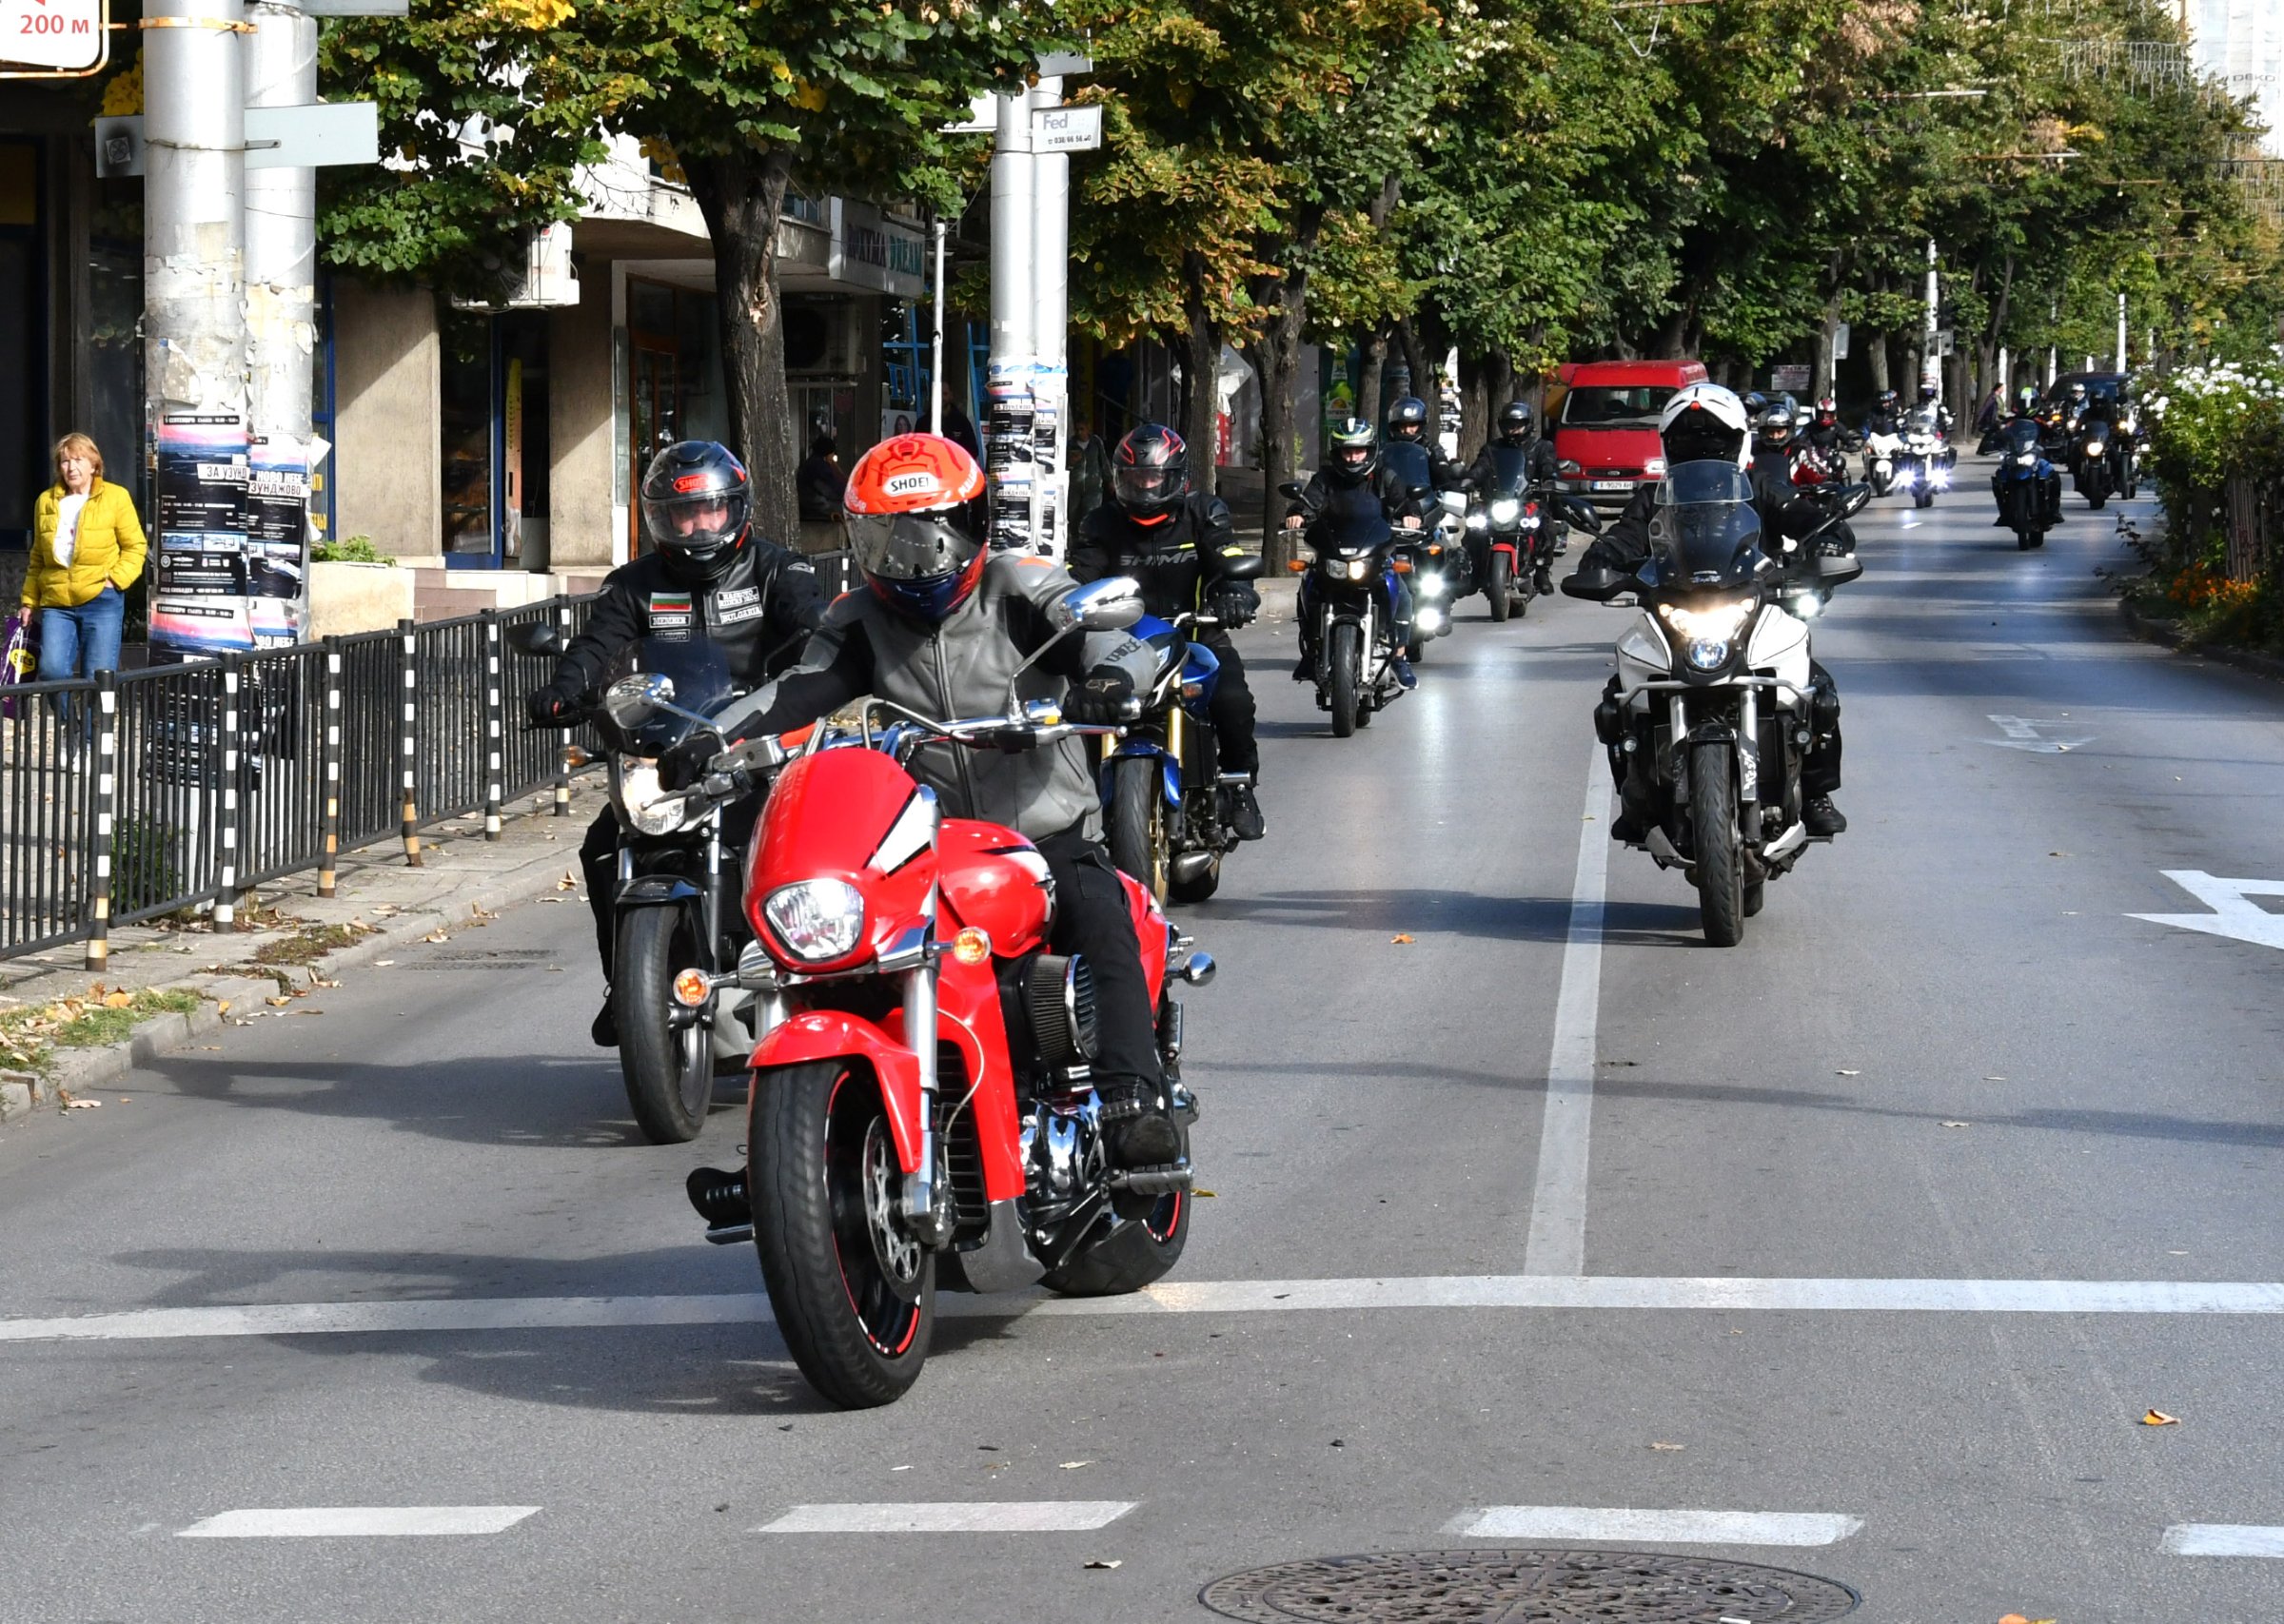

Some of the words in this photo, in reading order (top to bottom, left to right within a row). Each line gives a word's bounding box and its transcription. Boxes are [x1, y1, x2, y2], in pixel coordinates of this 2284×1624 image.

[20, 14, 64, 34] 200
[207, 466, 219, 478] ЗА
[257, 471, 283, 483] НОВО
[679, 476, 710, 490] SHOE
[890, 477, 930, 493] SHOEI
[1120, 549, 1198, 567] SHIMA
[721, 607, 762, 623] BULGARIA
